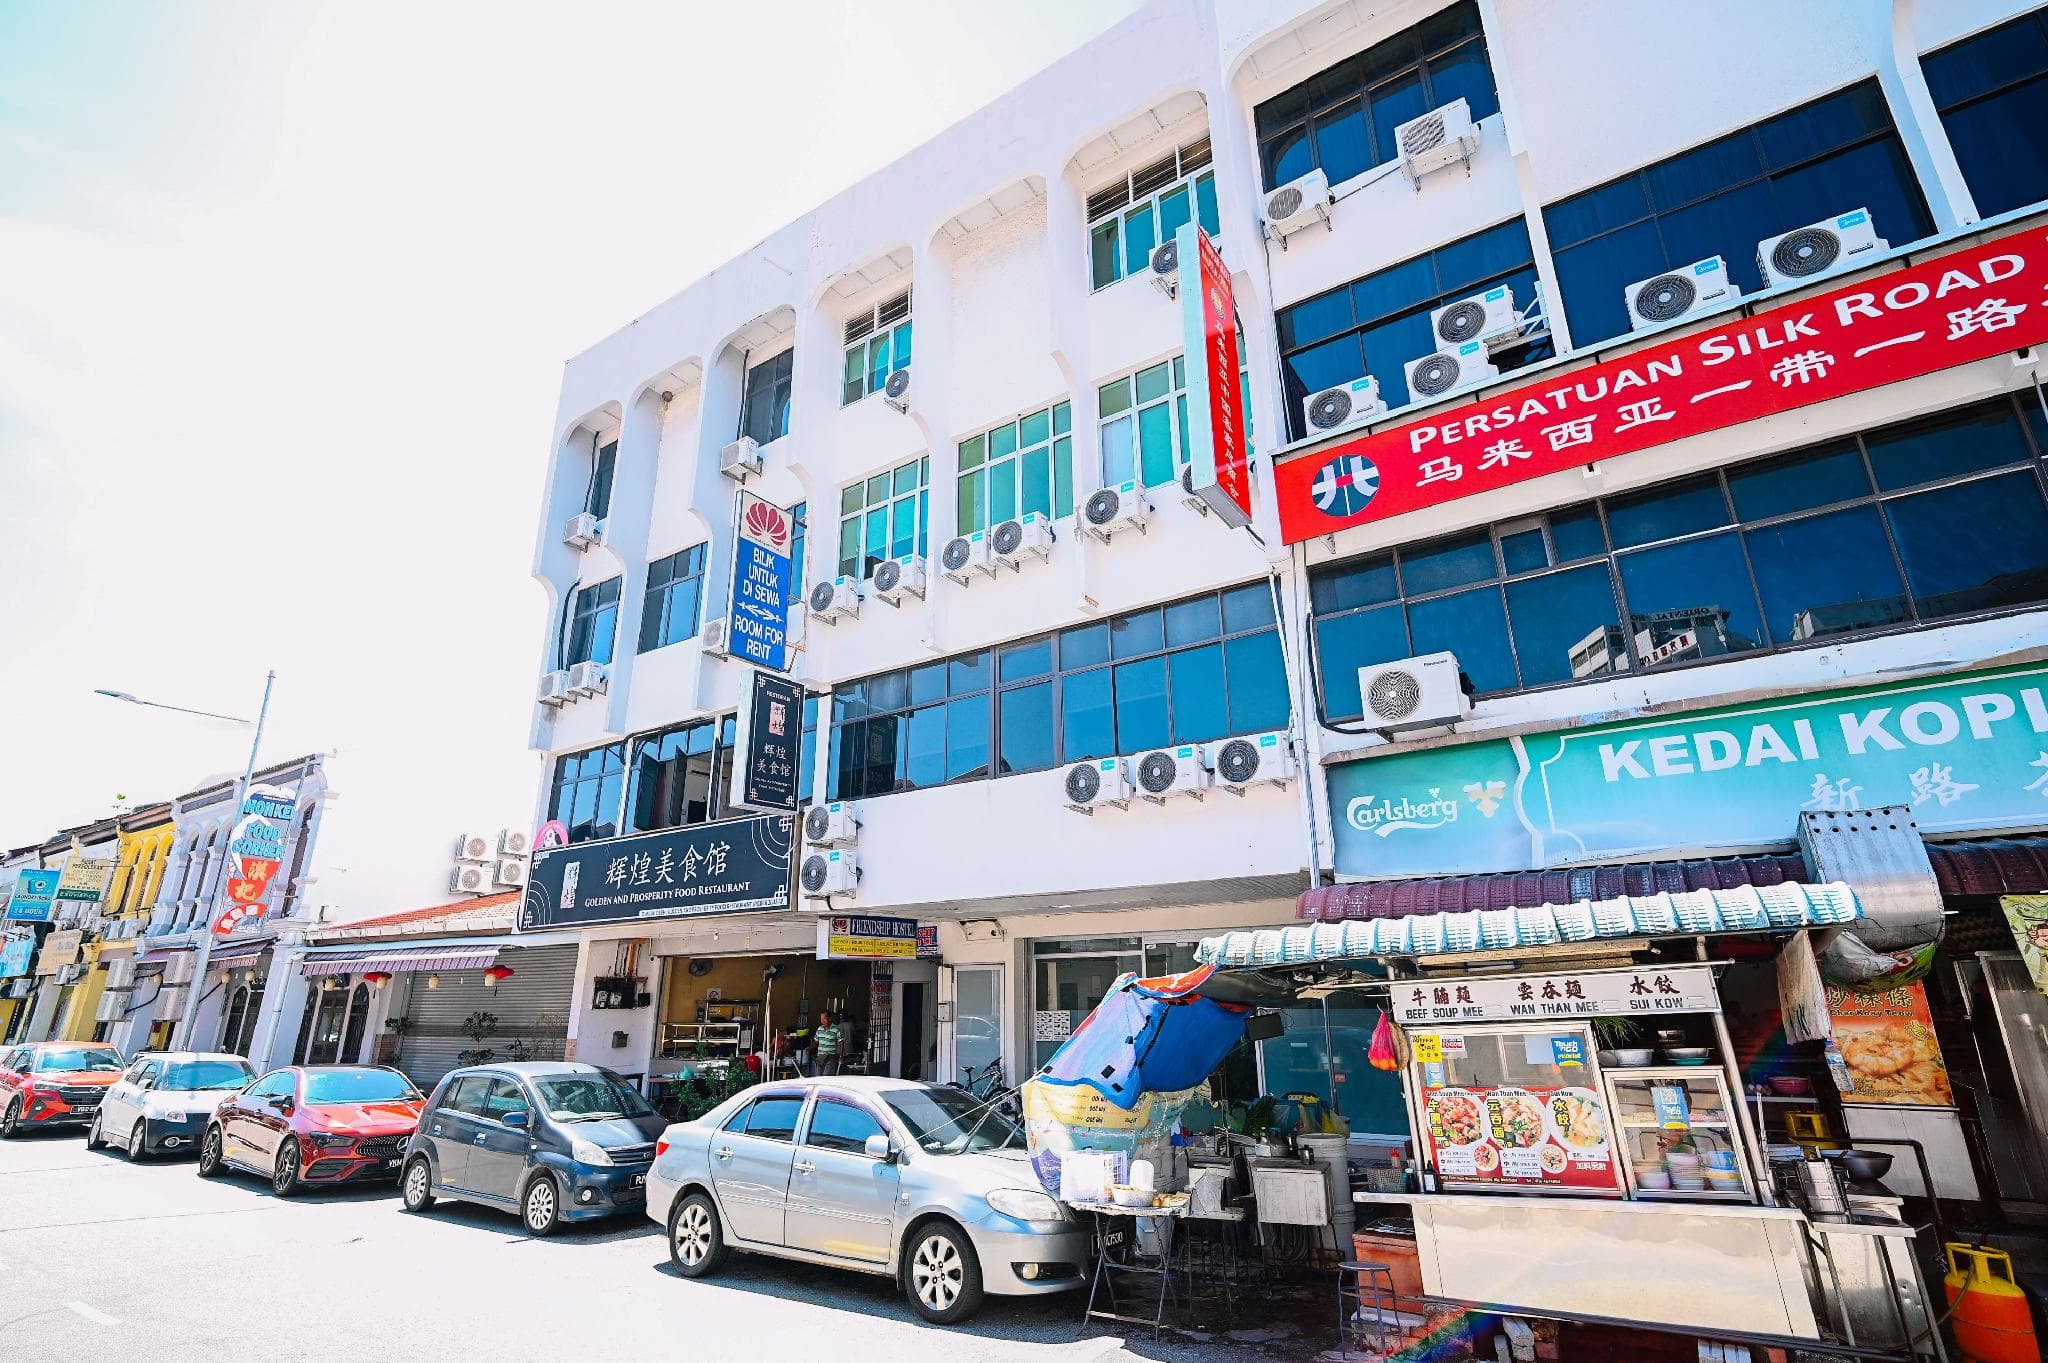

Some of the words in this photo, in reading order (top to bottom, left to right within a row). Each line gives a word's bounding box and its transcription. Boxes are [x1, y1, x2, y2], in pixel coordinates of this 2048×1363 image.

[1410, 354, 1683, 454] PERSATUAN
[1699, 313, 1821, 367] SILK
[1834, 253, 2025, 328] ROAD
[1416, 283, 2048, 488] 马来西亚一带一路
[753, 547, 775, 570] BILIK
[748, 563, 778, 590] UNTUK
[742, 579, 753, 597] DI
[754, 584, 780, 609] SEWA
[735, 614, 763, 640] ROOM
[764, 627, 784, 647] FOR
[746, 638, 772, 661] RENT
[1598, 717, 1820, 783] KEDAI
[1838, 687, 2048, 756] KOPI
[763, 742, 787, 760] 辉煌
[756, 758, 791, 777] 美食馆
[1346, 789, 1458, 838] Carlsberg
[245, 822, 281, 841] FOOD
[604, 840, 732, 891] 辉煌美食馆
[584, 895, 612, 908] GOLDEN
[613, 893, 629, 905] AND
[629, 889, 674, 903] PROSPERITY
[674, 886, 697, 899] FOOD
[698, 881, 751, 897] RESTAURANT
[851, 919, 891, 936] FRIENDSHIP
[892, 921, 915, 937] HOSTEL
[1629, 975, 1681, 996] 水餃
[1405, 1007, 1428, 1020] BEEF
[1432, 1006, 1459, 1019] SOUP
[1462, 1005, 1484, 1018] MEE
[1510, 1002, 1536, 1016] WAN
[1538, 1002, 1573, 1015] THAN
[1575, 1000, 1600, 1013] MEE
[1630, 998, 1652, 1011] SUI
[1653, 997, 1684, 1010] KOW
